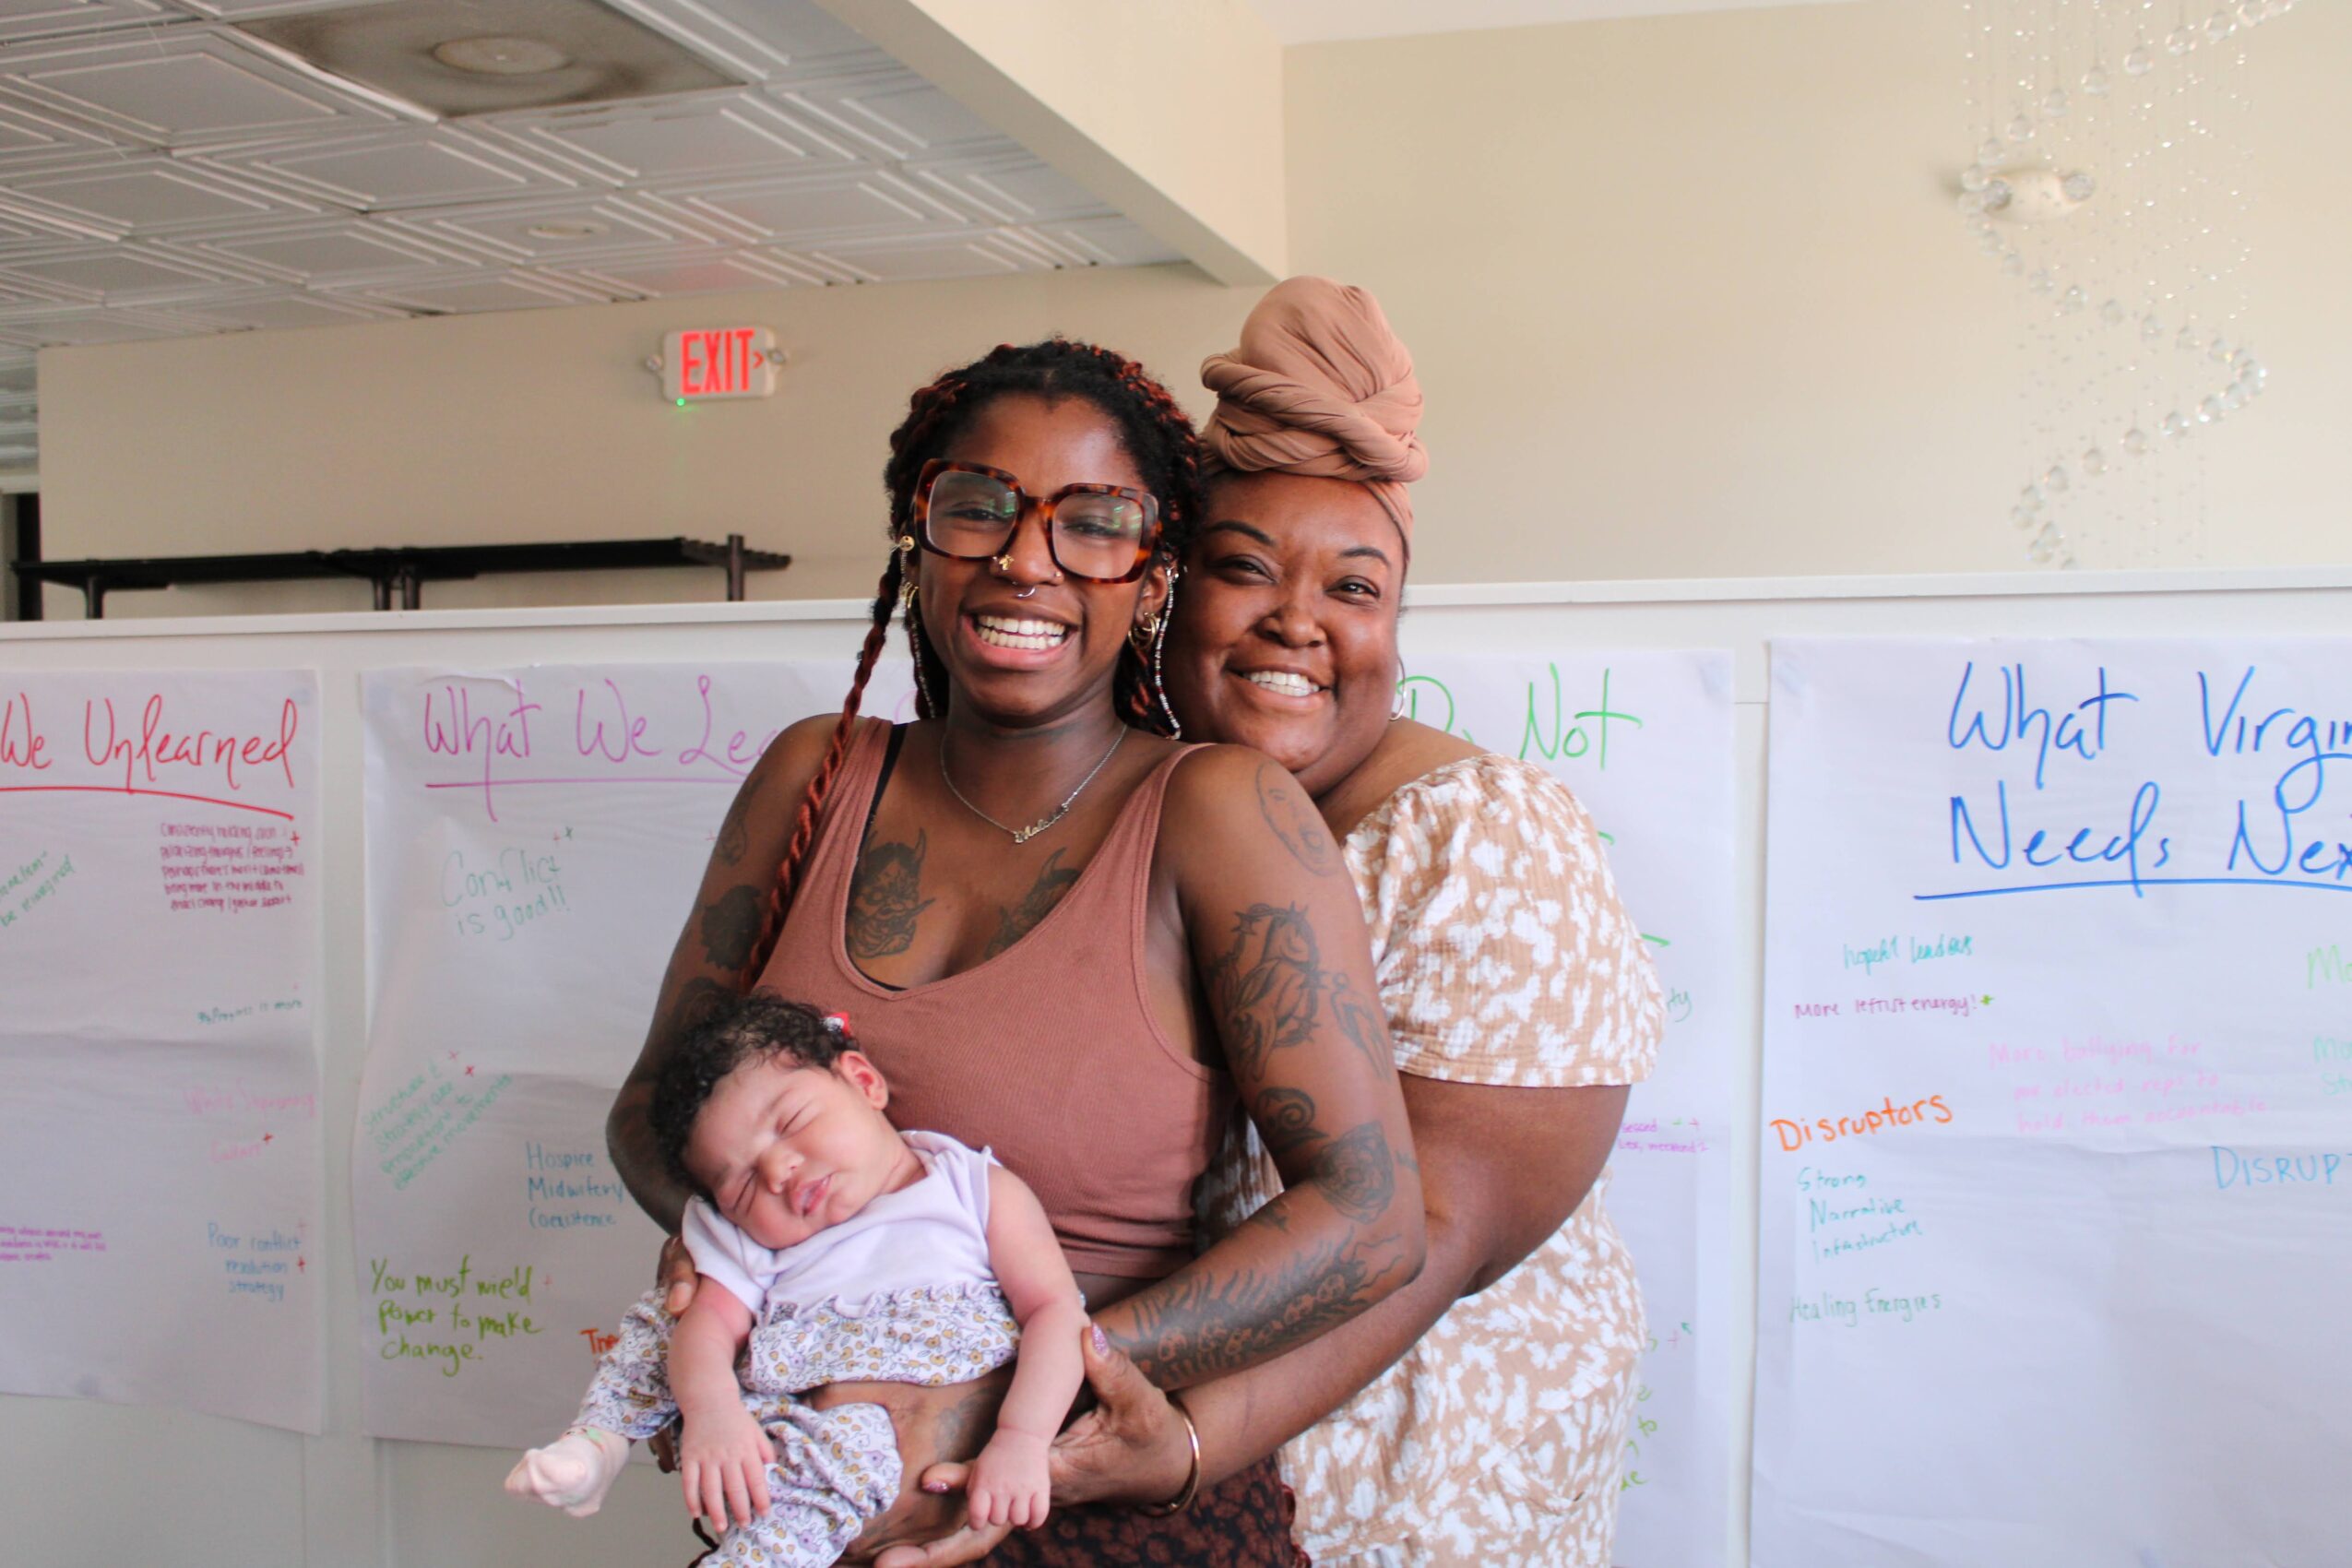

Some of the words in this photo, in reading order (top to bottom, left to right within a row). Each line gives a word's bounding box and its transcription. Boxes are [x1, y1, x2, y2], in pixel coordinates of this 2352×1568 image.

[680, 327, 755, 396] EXIT
[0, 692, 53, 769] We
[84, 693, 298, 794] Unlearned
[1396, 674, 1476, 744] D
[1519, 662, 1643, 771] Not
[1948, 660, 2140, 790] What
[424, 678, 542, 823] What
[576, 677, 663, 764] We
[1950, 780, 2170, 897] Needs
[2227, 786, 2352, 881] Nex
[440, 843, 562, 909] Conflict
[457, 913, 485, 938] is
[493, 884, 572, 942] good!!
[1769, 1094, 1954, 1152] Disruptors
[525, 1140, 596, 1171] Hospice
[1797, 1166, 1868, 1192] Strong
[2209, 1145, 2352, 1191] DISRUP
[527, 1174, 625, 1206] Midwifery
[1809, 1197, 1906, 1233] Narrative
[370, 1257, 407, 1295] You
[415, 1253, 471, 1300] must
[452, 1302, 471, 1332] to
[478, 1311, 546, 1341] make
[380, 1333, 484, 1379] change.
